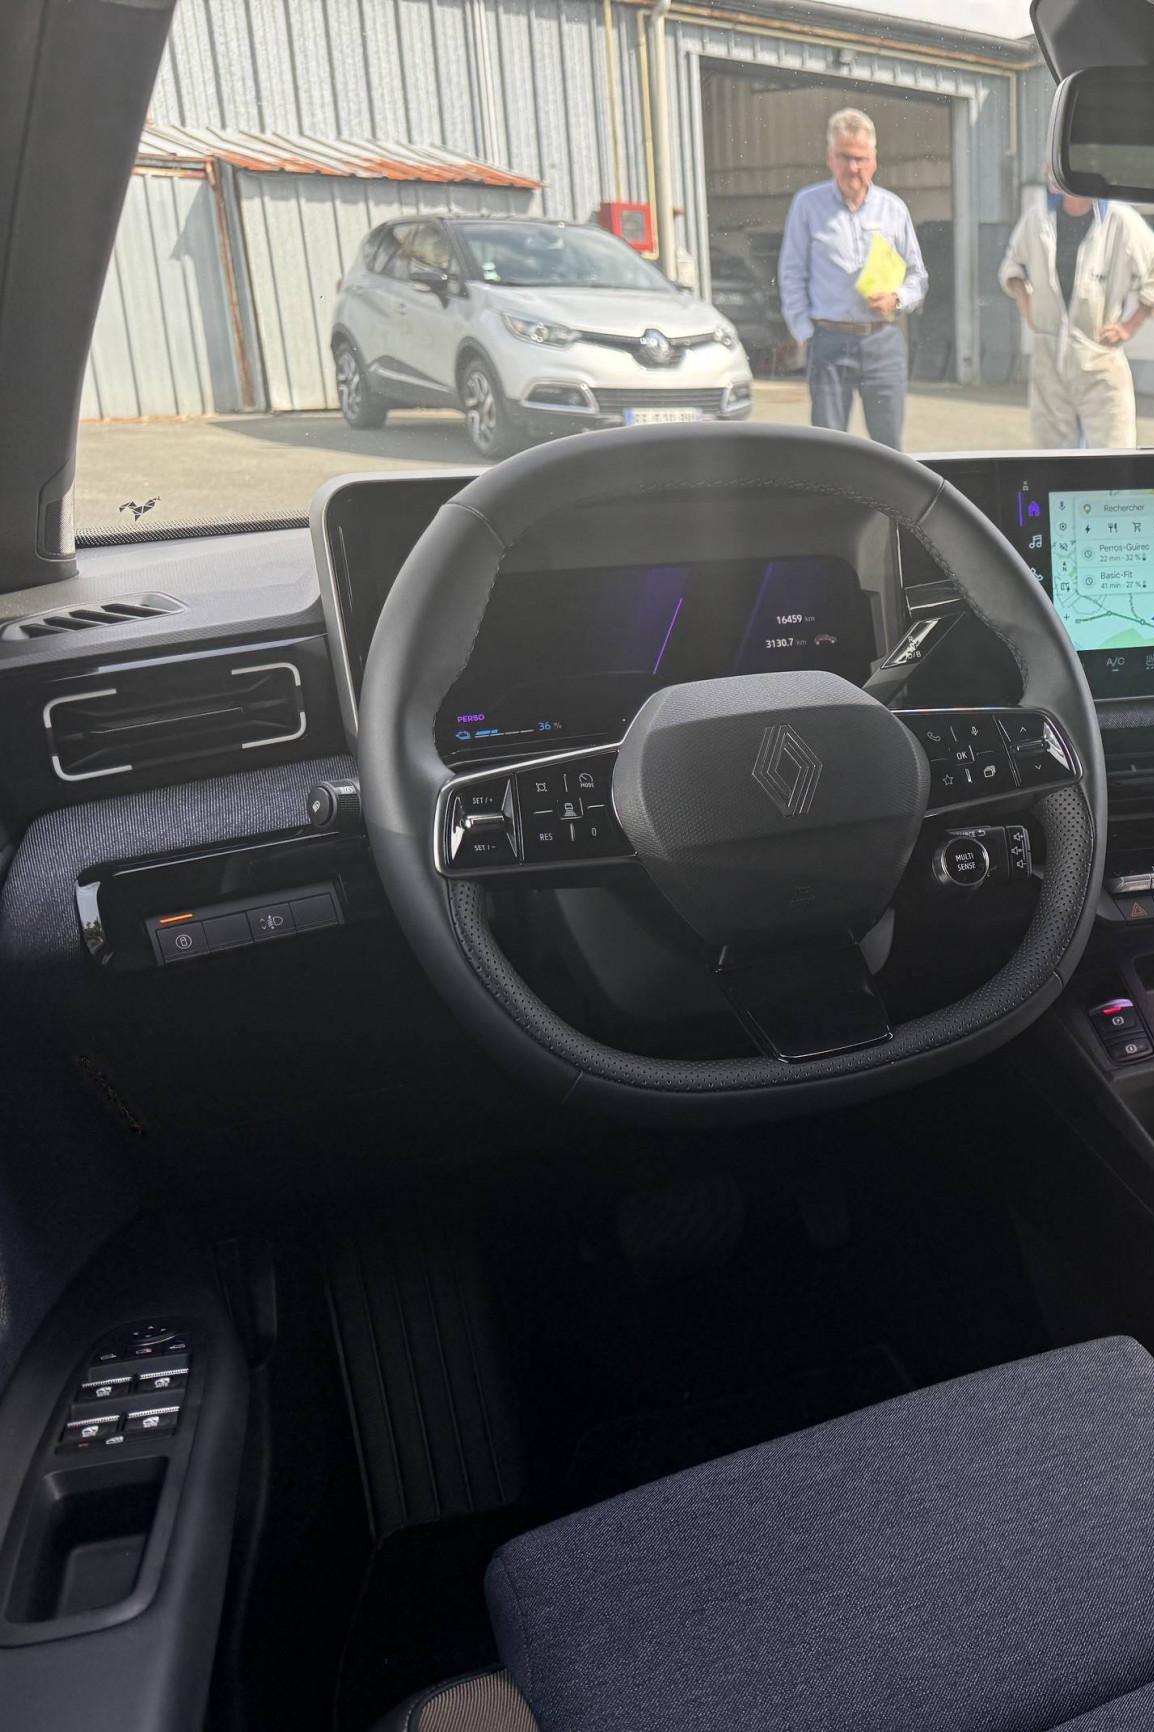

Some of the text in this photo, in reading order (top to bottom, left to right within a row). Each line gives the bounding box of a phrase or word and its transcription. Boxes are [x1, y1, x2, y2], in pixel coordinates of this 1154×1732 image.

[1103, 503, 1145, 513] Rechercher
[1099, 543, 1150, 552] Perros-Guirec
[1100, 555, 1108, 563] 22
[1109, 554, 1121, 563] min
[1126, 553, 1134, 562] 32
[1100, 571, 1133, 580] Basic-Fit
[1109, 582, 1122, 590] min
[1126, 581, 1134, 589] 27
[776, 614, 803, 625] 16459
[766, 637, 794, 648] 3130.7
[1106, 657, 1126, 666] A/C
[457, 713, 485, 723] PERSO
[538, 721, 551, 731] 36
[956, 751, 968, 760] OK
[472, 797, 484, 805] SET
[539, 833, 553, 841] RES
[955, 852, 974, 862] MULTI
[957, 862, 976, 871] SENSE
